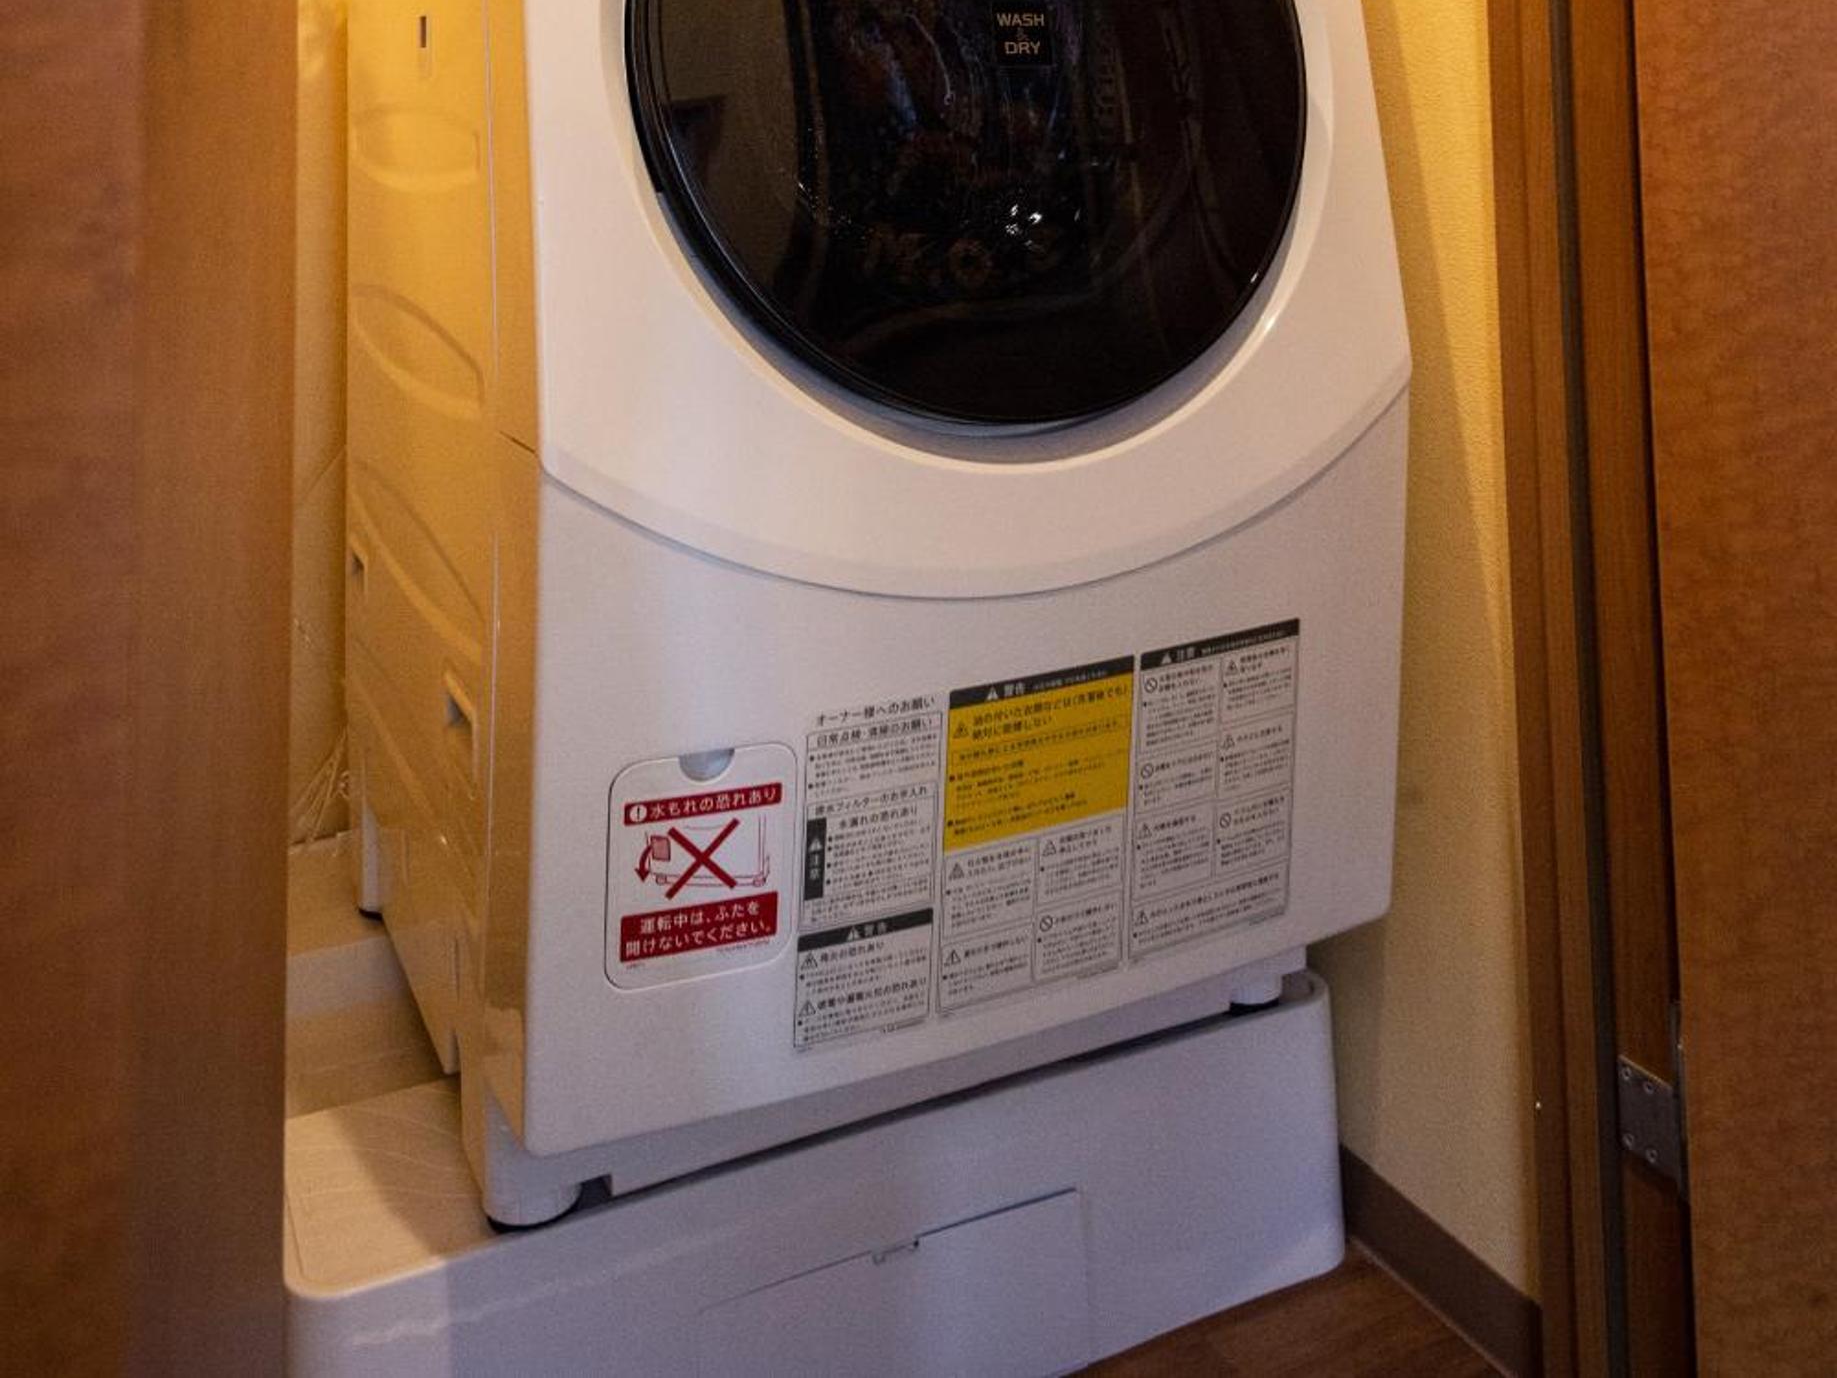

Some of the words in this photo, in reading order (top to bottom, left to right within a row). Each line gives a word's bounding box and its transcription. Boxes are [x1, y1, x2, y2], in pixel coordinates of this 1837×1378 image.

[997, 13, 1044, 26] WASH
[1004, 41, 1040, 54] DRY
[818, 697, 935, 726] オーナー様へのお願い
[650, 788, 777, 820] 水もれの恐れあり
[640, 904, 760, 934] 運転中は、ふたを
[626, 922, 772, 956] 開けないでください。
